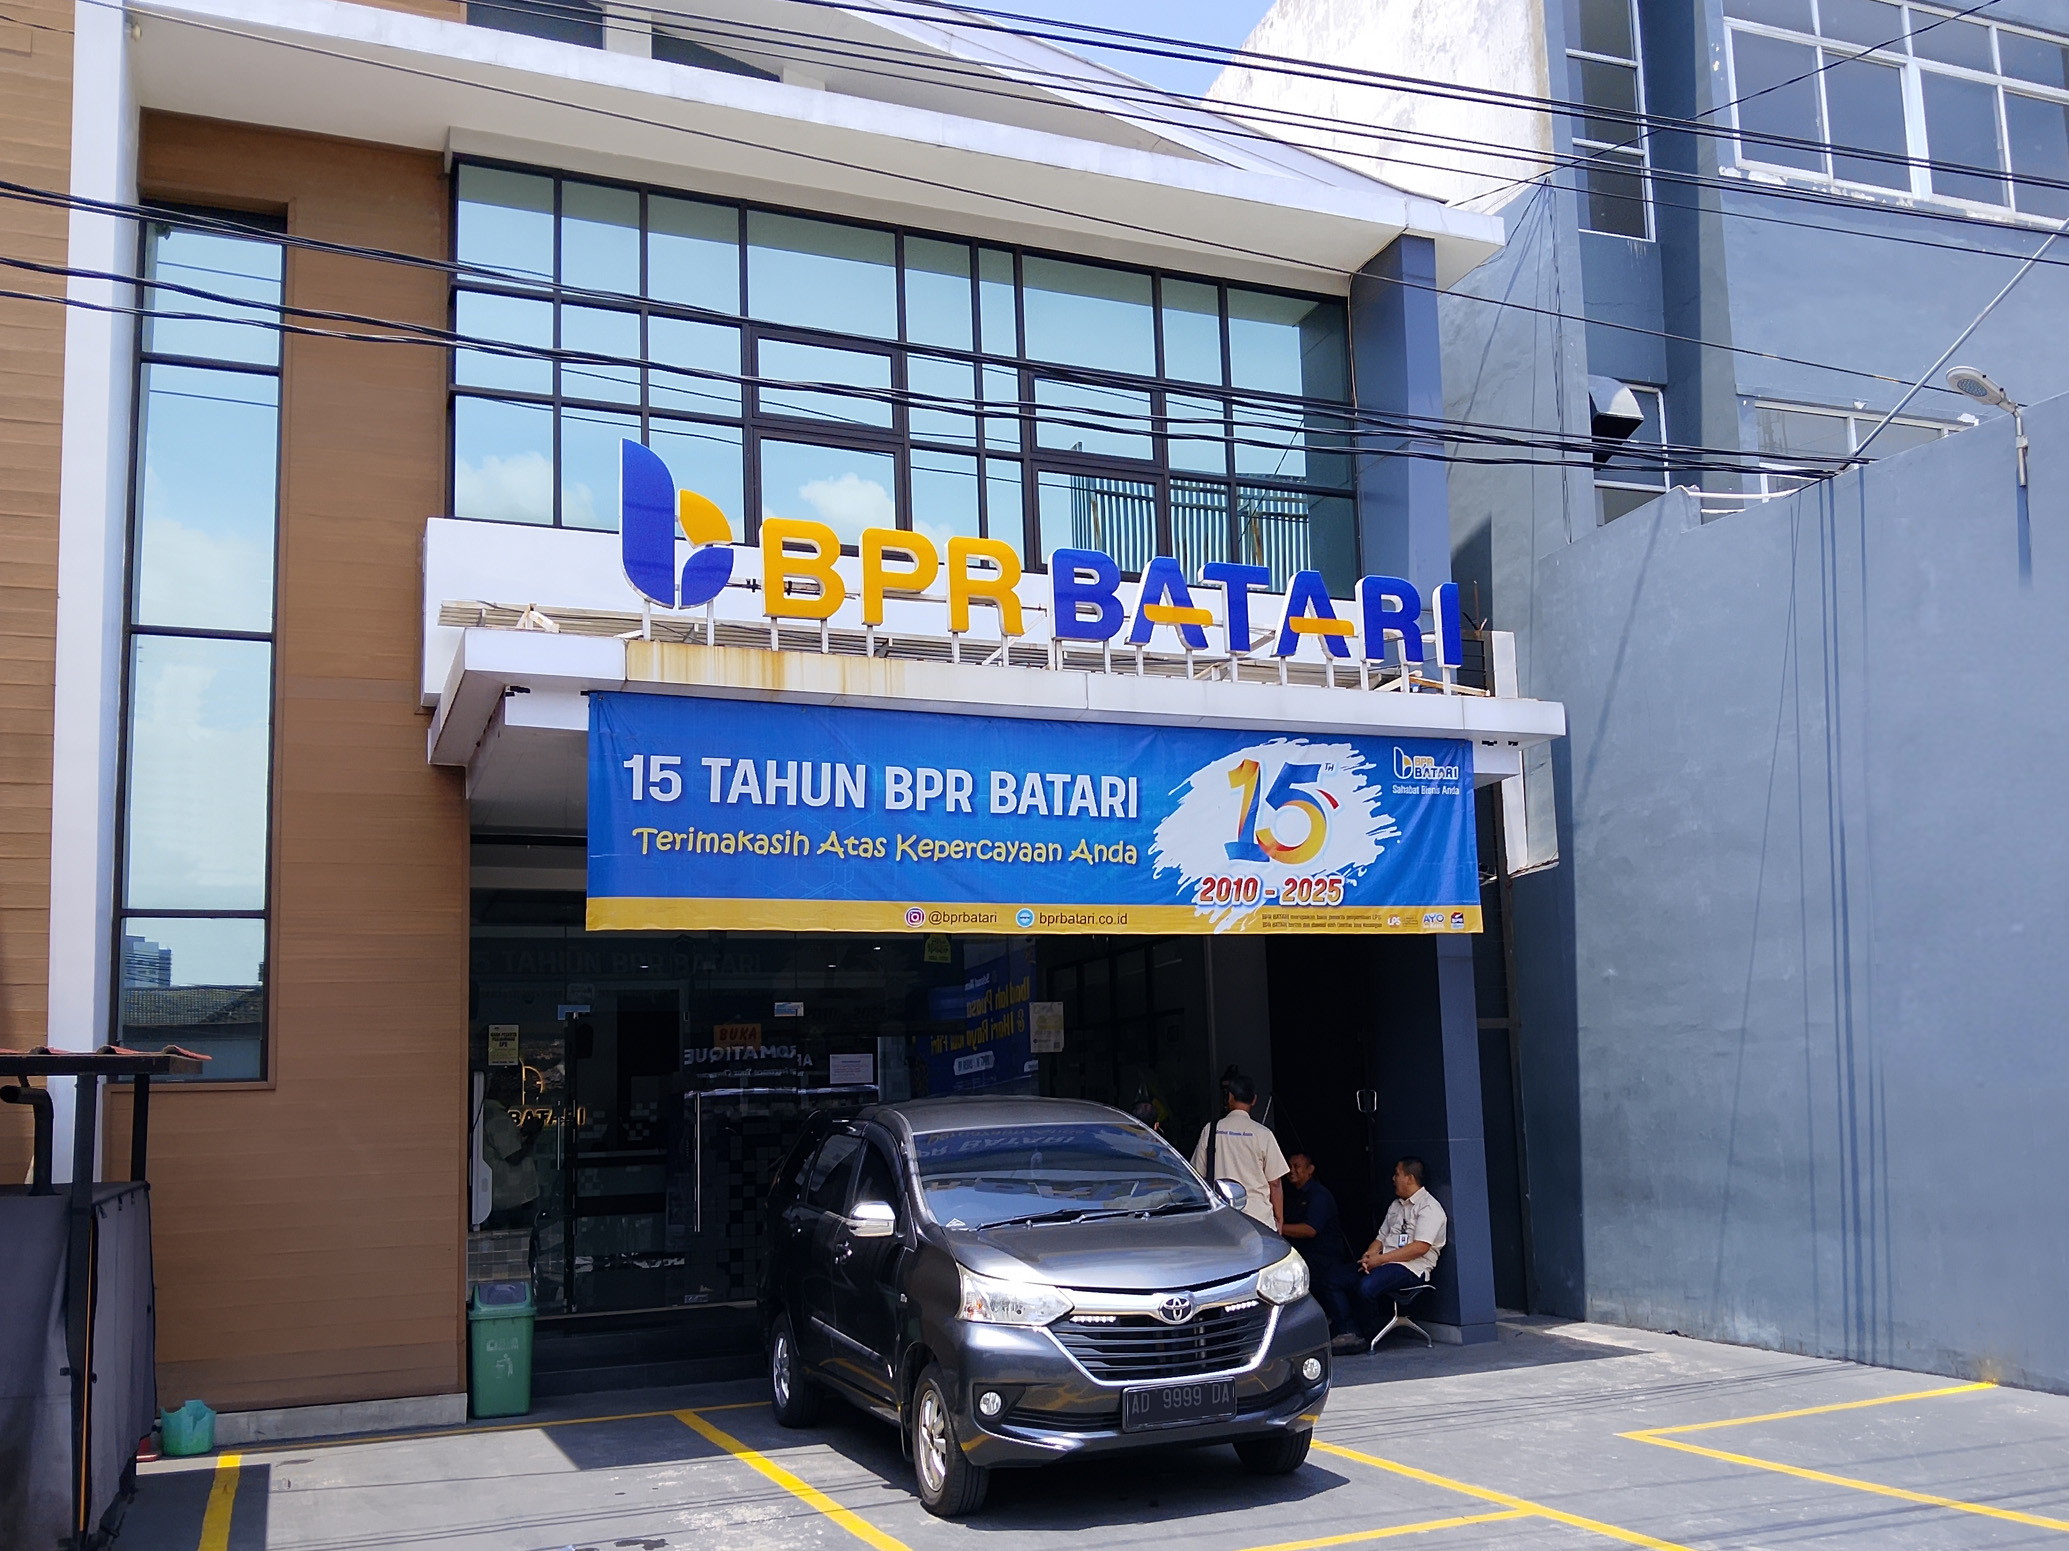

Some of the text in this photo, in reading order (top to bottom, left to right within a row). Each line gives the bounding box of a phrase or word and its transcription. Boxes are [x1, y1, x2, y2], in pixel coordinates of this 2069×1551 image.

[758, 518, 1463, 668] BPR BATARI
[1414, 756, 1433, 767] BPR
[1414, 767, 1458, 778] BATARI
[623, 754, 1138, 818] 15 TAHUN BPR BATARI
[1442, 785, 1460, 795] Anda
[1224, 758, 1328, 865] 15
[632, 827, 1138, 865] Terimakasih Atas Kepercayaan Anda
[1198, 877, 1259, 903] 2010
[1280, 878, 1344, 903] 2025
[928, 911, 998, 926] @bprbatari
[1039, 912, 1128, 926] bprbatari.co.id
[1423, 913, 1445, 924] AYO
[718, 1026, 758, 1042] BUKA
[1131, 1383, 1230, 1414] AD 9999 DA
